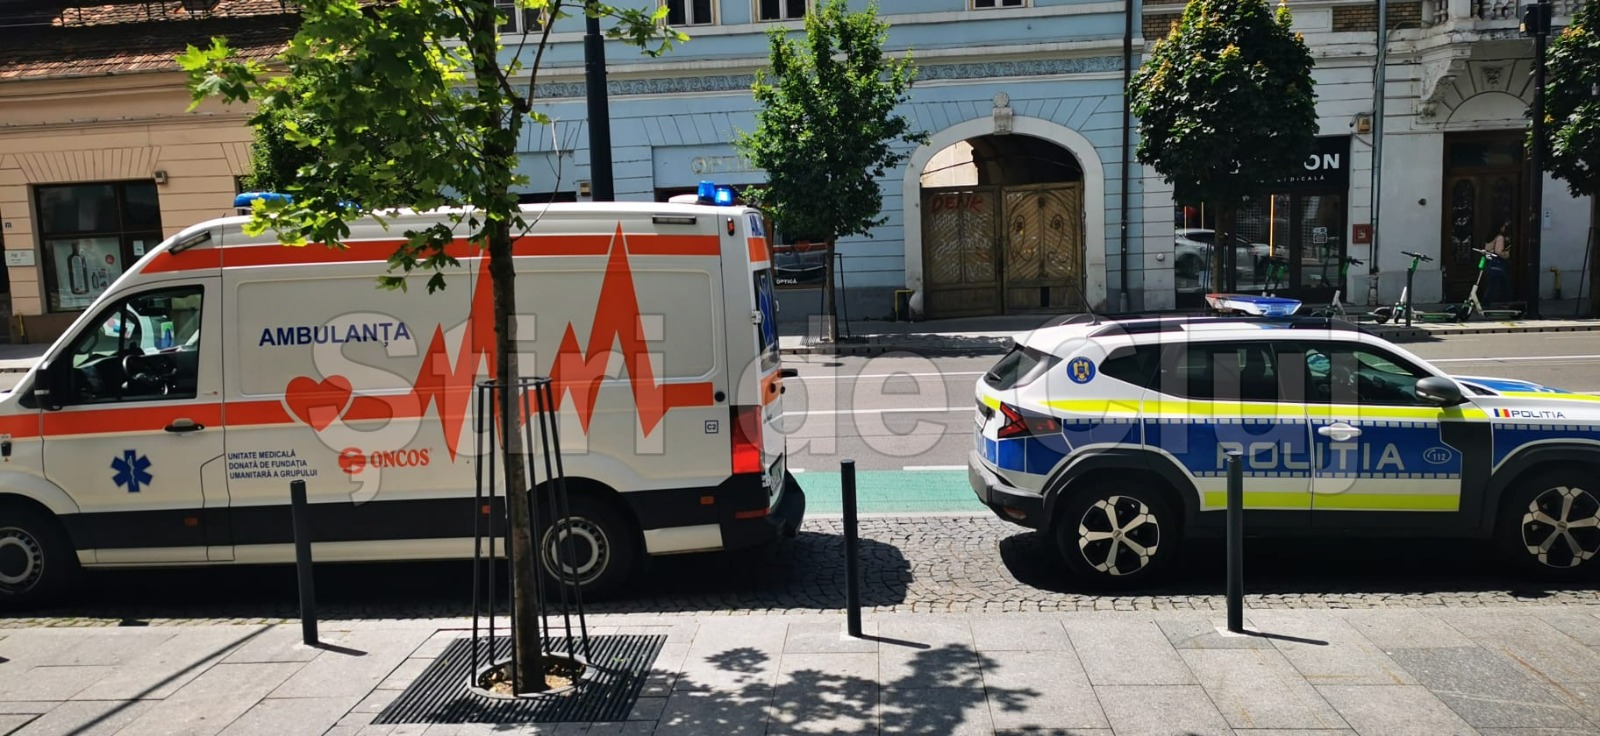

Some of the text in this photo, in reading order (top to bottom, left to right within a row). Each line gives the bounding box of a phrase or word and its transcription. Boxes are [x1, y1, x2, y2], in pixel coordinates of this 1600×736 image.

[258, 322, 411, 348] AMBULANȚA
[1511, 410, 1566, 419] POLITIA
[706, 423, 717, 431] C2
[228, 452, 257, 460] UNITATE
[370, 449, 430, 468] ONCOS
[1216, 442, 1405, 471] POLITIA
[1432, 453, 1447, 462] 112
[259, 461, 270, 469] DE
[273, 470, 279, 478] A
[281, 469, 318, 478] GRUPULUI
